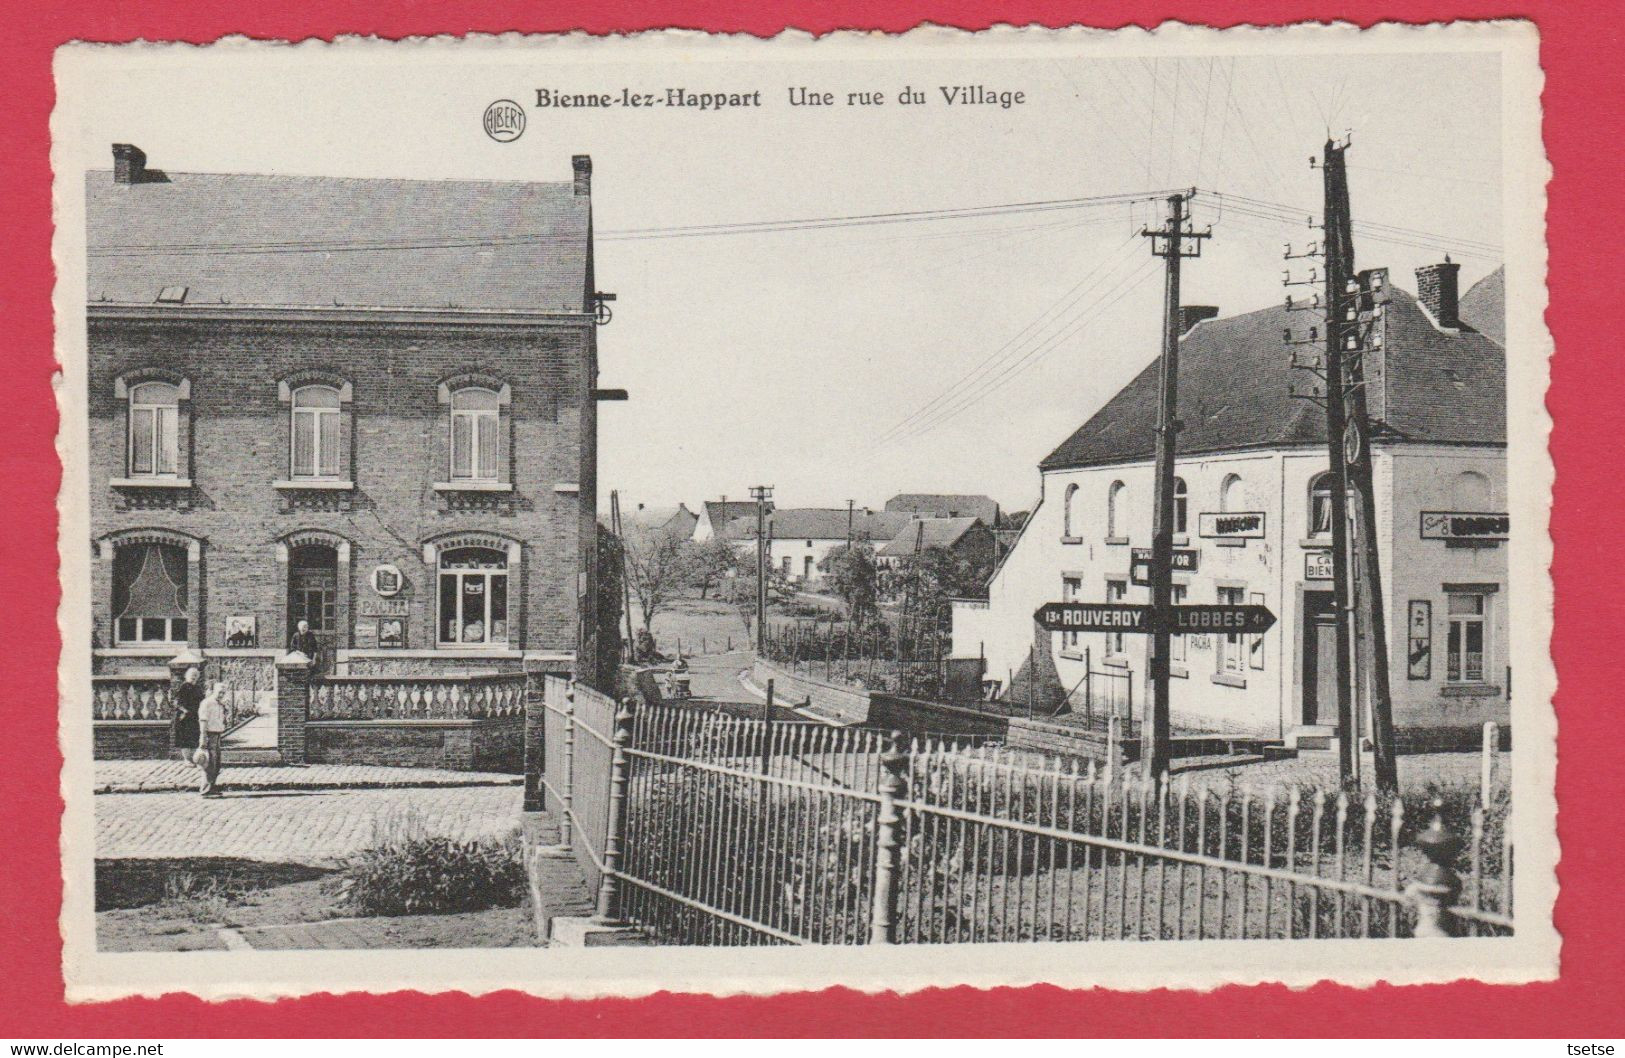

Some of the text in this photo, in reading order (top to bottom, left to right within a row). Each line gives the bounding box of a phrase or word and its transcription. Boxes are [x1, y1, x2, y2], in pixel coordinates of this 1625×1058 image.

[535, 85, 1026, 111] Bienne-lez-Happart Une rue du Village
[486, 106, 523, 135] ALBERT
[1063, 609, 1142, 626] ROUVEROY
[1178, 611, 1245, 627] LOBBES
[1190, 635, 1212, 651] PACHA
